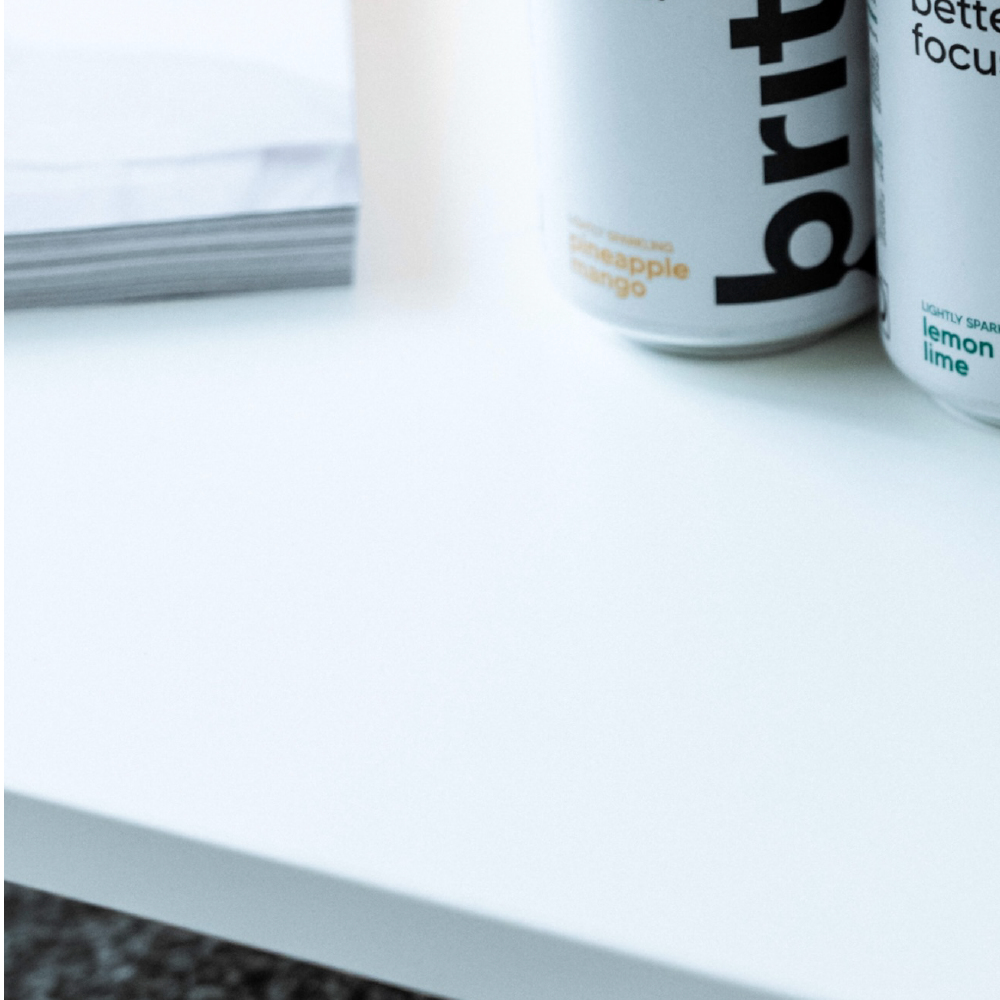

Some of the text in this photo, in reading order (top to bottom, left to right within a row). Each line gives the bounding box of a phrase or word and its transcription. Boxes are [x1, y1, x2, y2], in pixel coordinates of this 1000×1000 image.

[569, 233, 689, 281] pineapple
[570, 256, 648, 300] mango
[921, 299, 963, 325] LIGHTLY
[923, 315, 994, 359] lemon
[924, 340, 969, 377] lime
